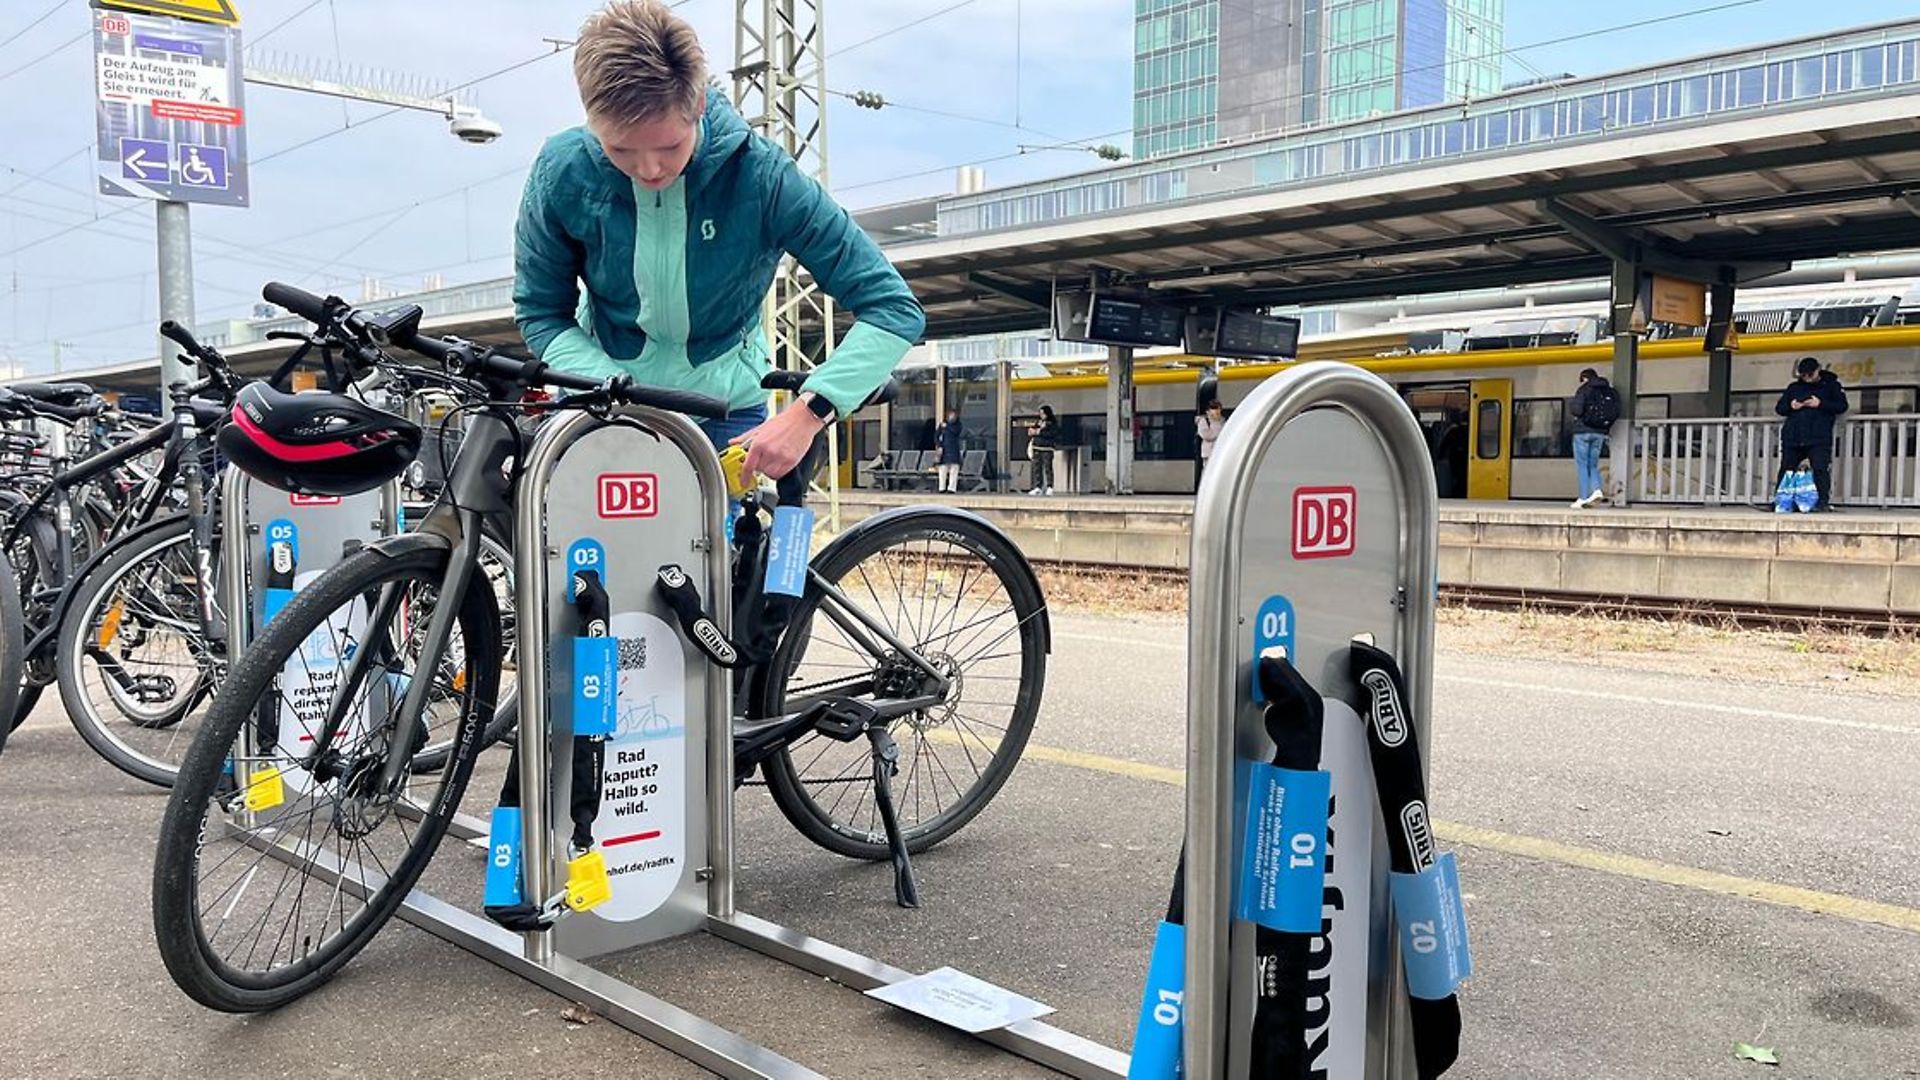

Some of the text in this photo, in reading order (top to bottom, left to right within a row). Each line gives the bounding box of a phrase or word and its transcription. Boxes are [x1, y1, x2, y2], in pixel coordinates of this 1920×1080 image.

[104, 19, 128, 33] DB
[103, 57, 197, 78] Der Aufzug am
[103, 70, 197, 90] Gleis 1 wird für
[103, 82, 186, 99] Sie erneuert.
[604, 479, 652, 513] DB
[1299, 495, 1350, 549] DB
[270, 526, 293, 540] 05
[574, 547, 599, 565] 03
[1262, 612, 1288, 638] 01
[583, 674, 601, 698] 03
[1373, 676, 1401, 735] ABUS
[617, 748, 645, 765] Rad
[604, 764, 660, 784] kaputt?
[605, 784, 658, 801] Halb so
[614, 802, 649, 817] wild.
[494, 844, 512, 868] 03
[1289, 833, 1316, 869] 01
[1409, 919, 1437, 954] 02
[1153, 987, 1184, 1026] 01
